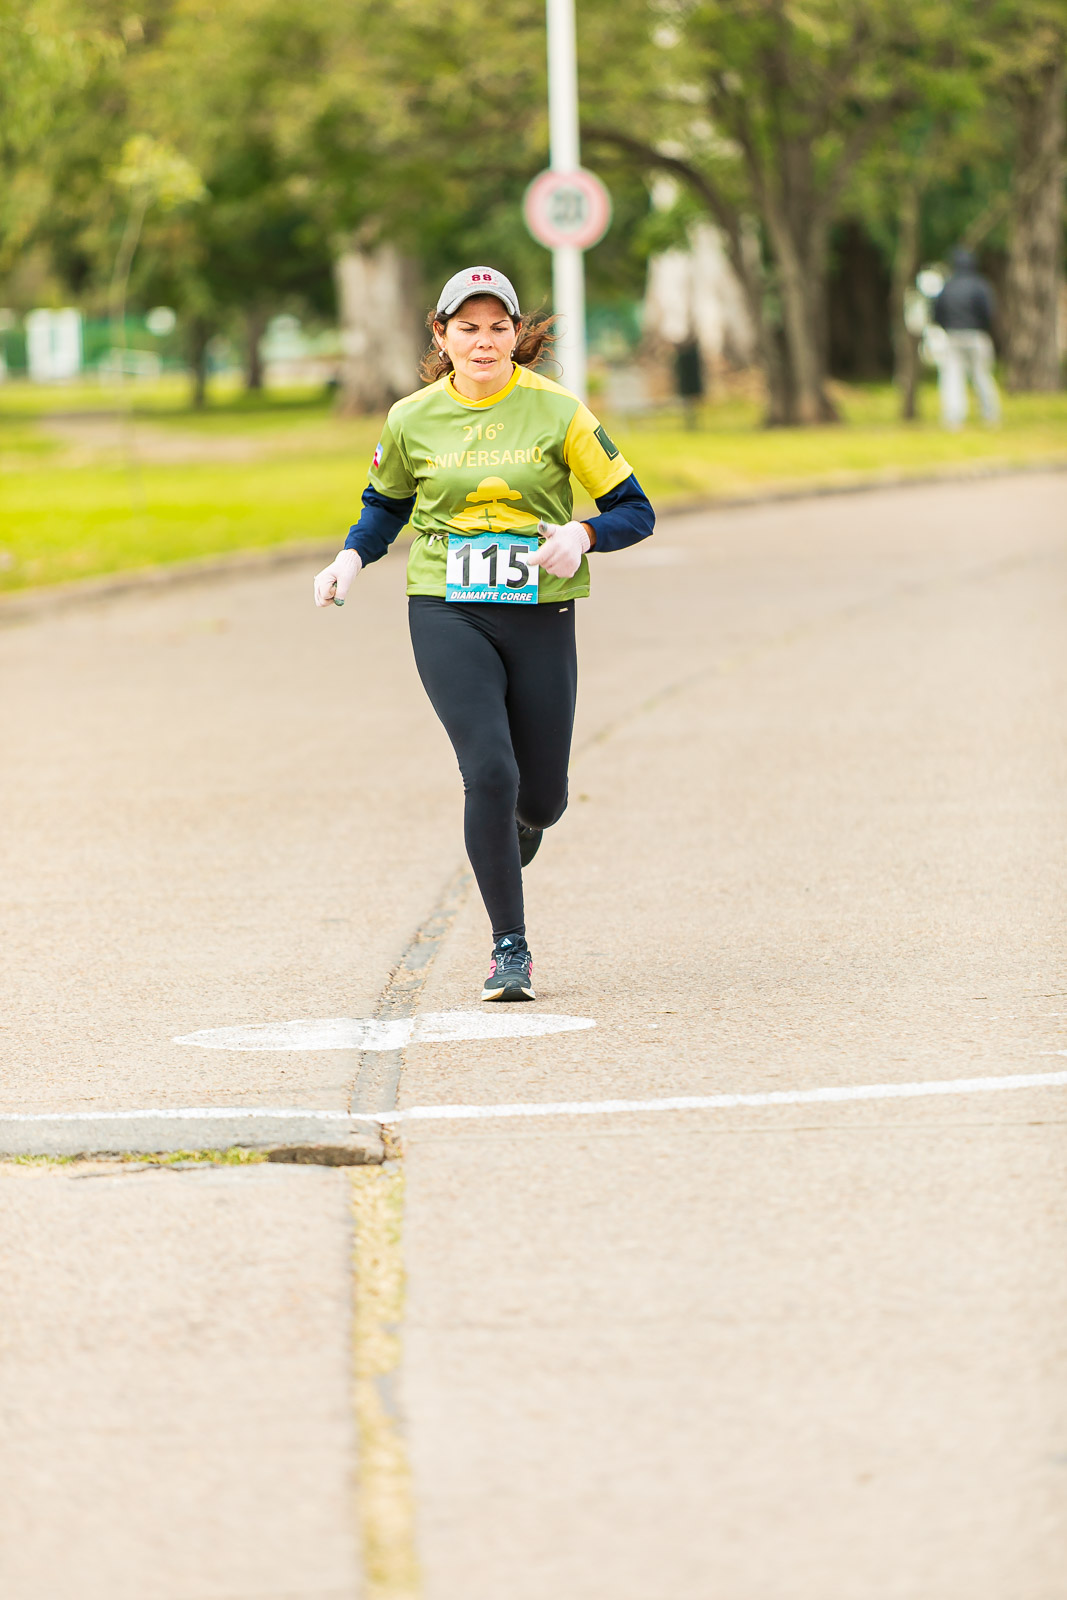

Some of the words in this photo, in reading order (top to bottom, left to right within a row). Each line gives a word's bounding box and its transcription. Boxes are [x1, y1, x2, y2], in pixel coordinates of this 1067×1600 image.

[463, 422, 504, 442] 216°
[425, 445, 542, 471] ANIVERSARIO
[455, 543, 530, 589] 115
[450, 591, 499, 600] DIAMANTE
[500, 592, 533, 601] CORRE
